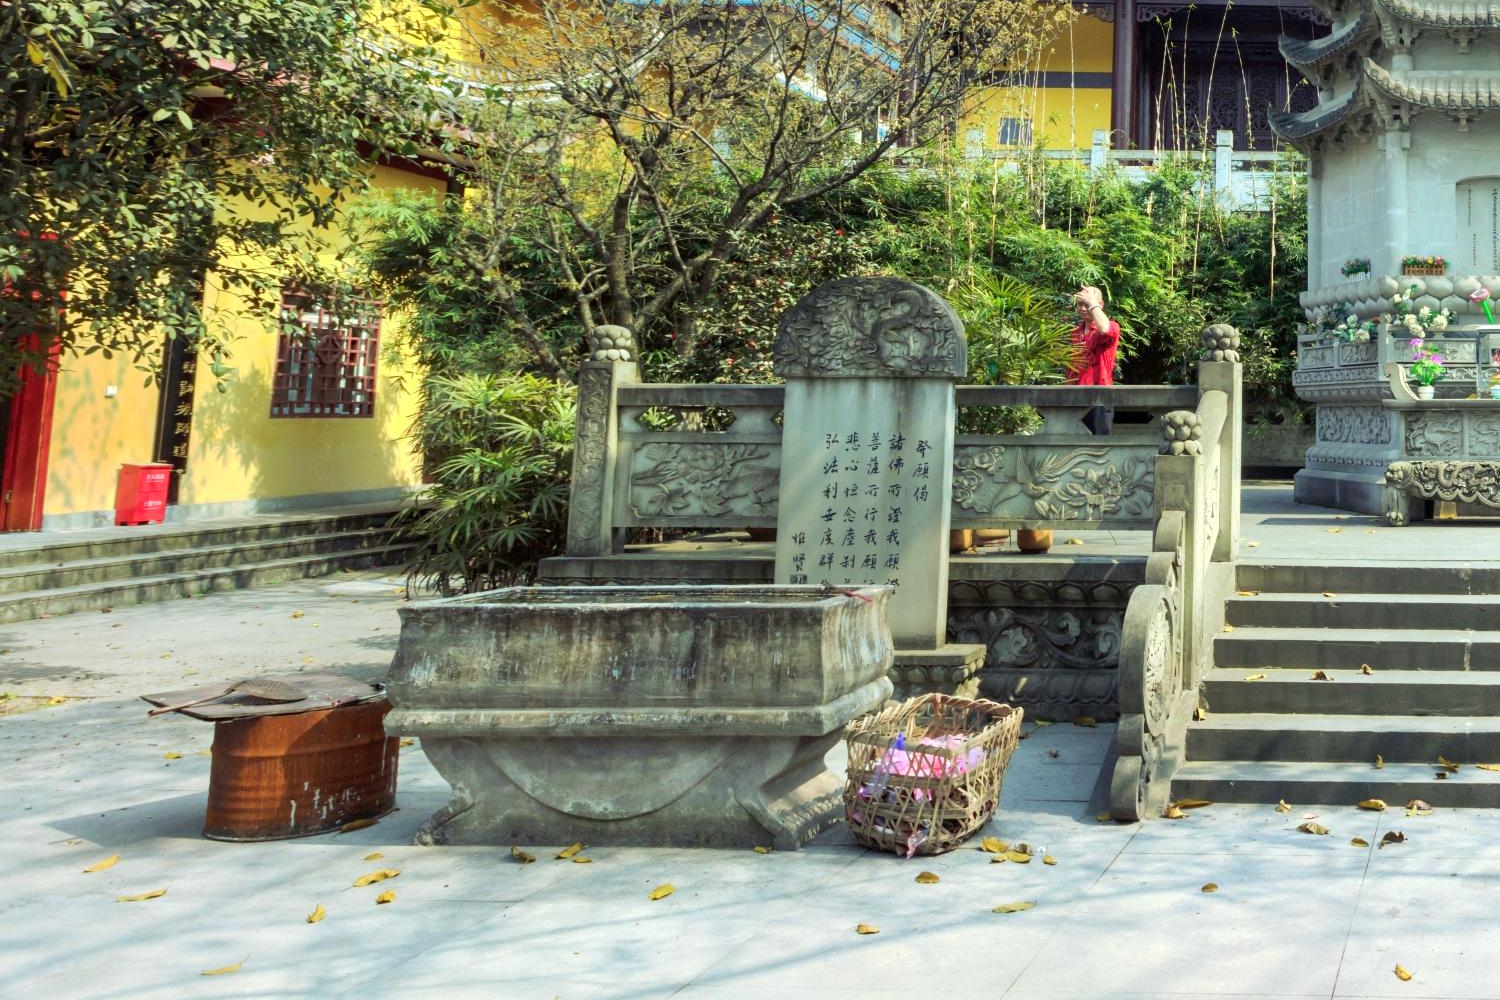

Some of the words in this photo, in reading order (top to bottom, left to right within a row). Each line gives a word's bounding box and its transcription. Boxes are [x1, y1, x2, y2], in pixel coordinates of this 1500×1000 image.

[818, 433, 839, 587] 弘法利世度群
[861, 432, 881, 585] 菩薩所行我願
